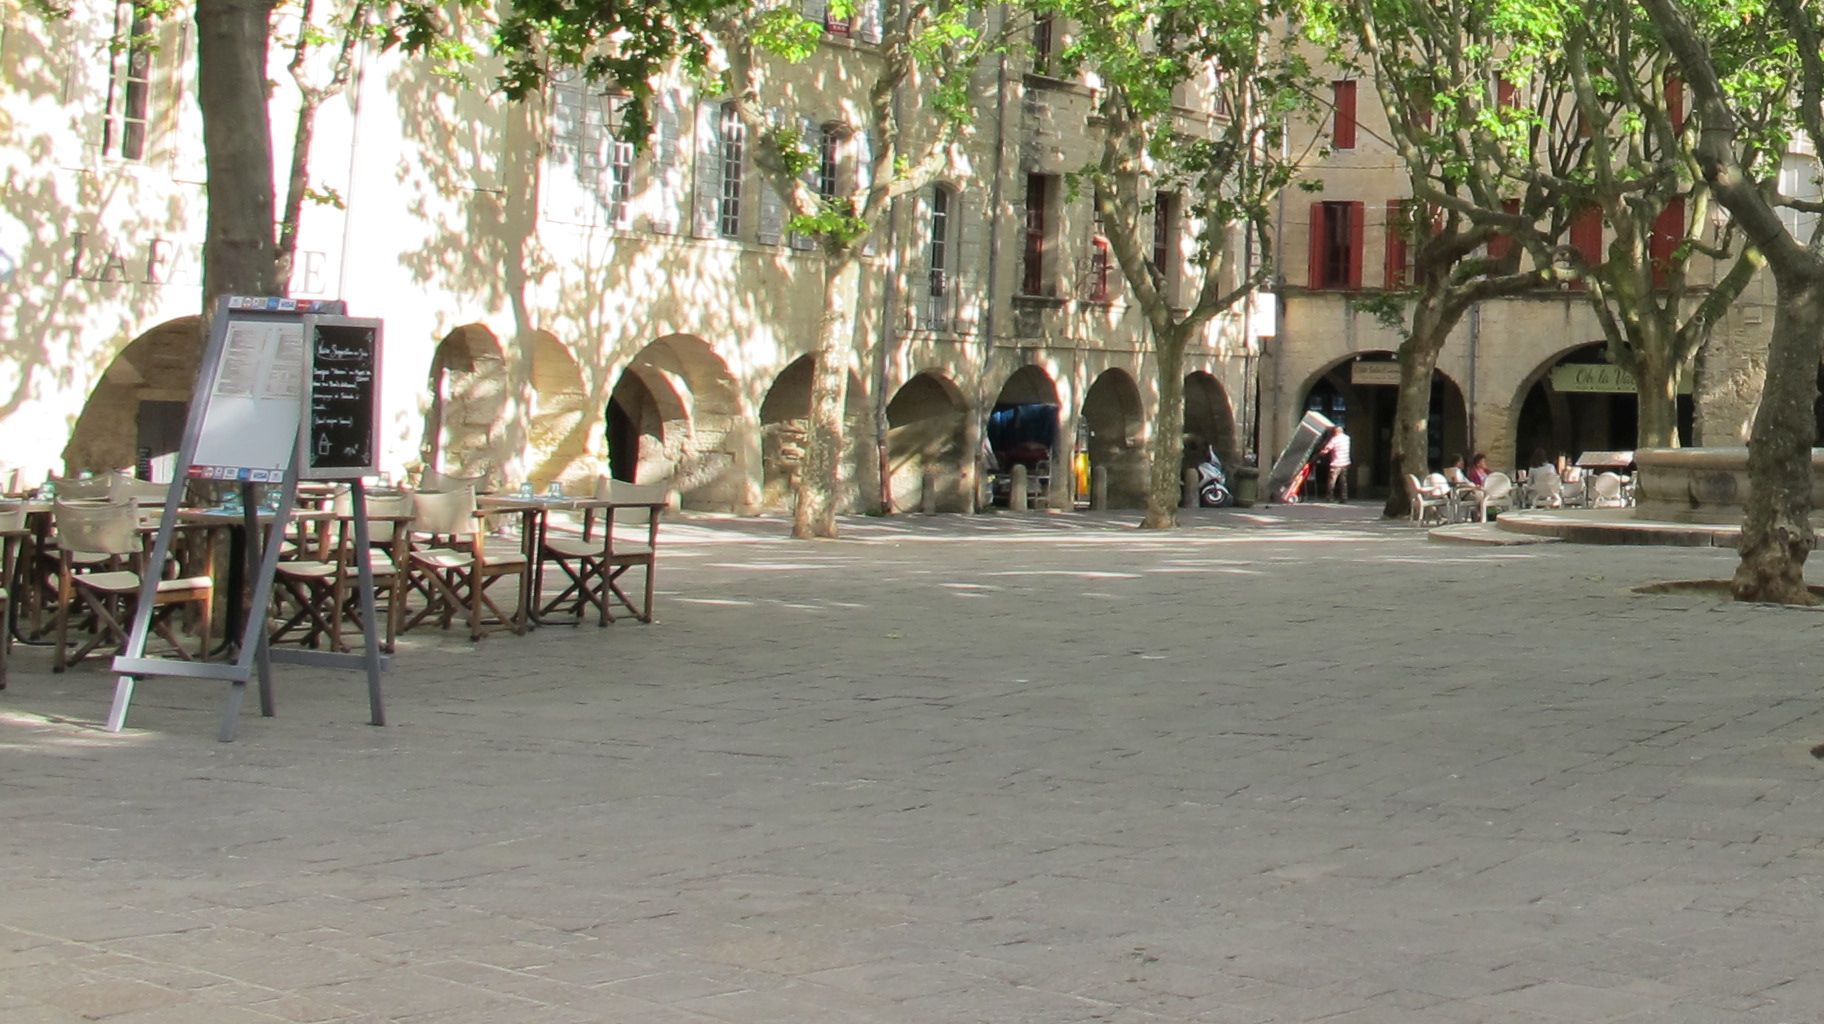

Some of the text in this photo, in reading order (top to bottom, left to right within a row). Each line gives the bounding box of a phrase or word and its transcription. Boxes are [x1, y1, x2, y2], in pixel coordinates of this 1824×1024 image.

[65, 232, 131, 284] LA
[1575, 367, 1592, 384] Oh
[1599, 368, 1609, 384] la
